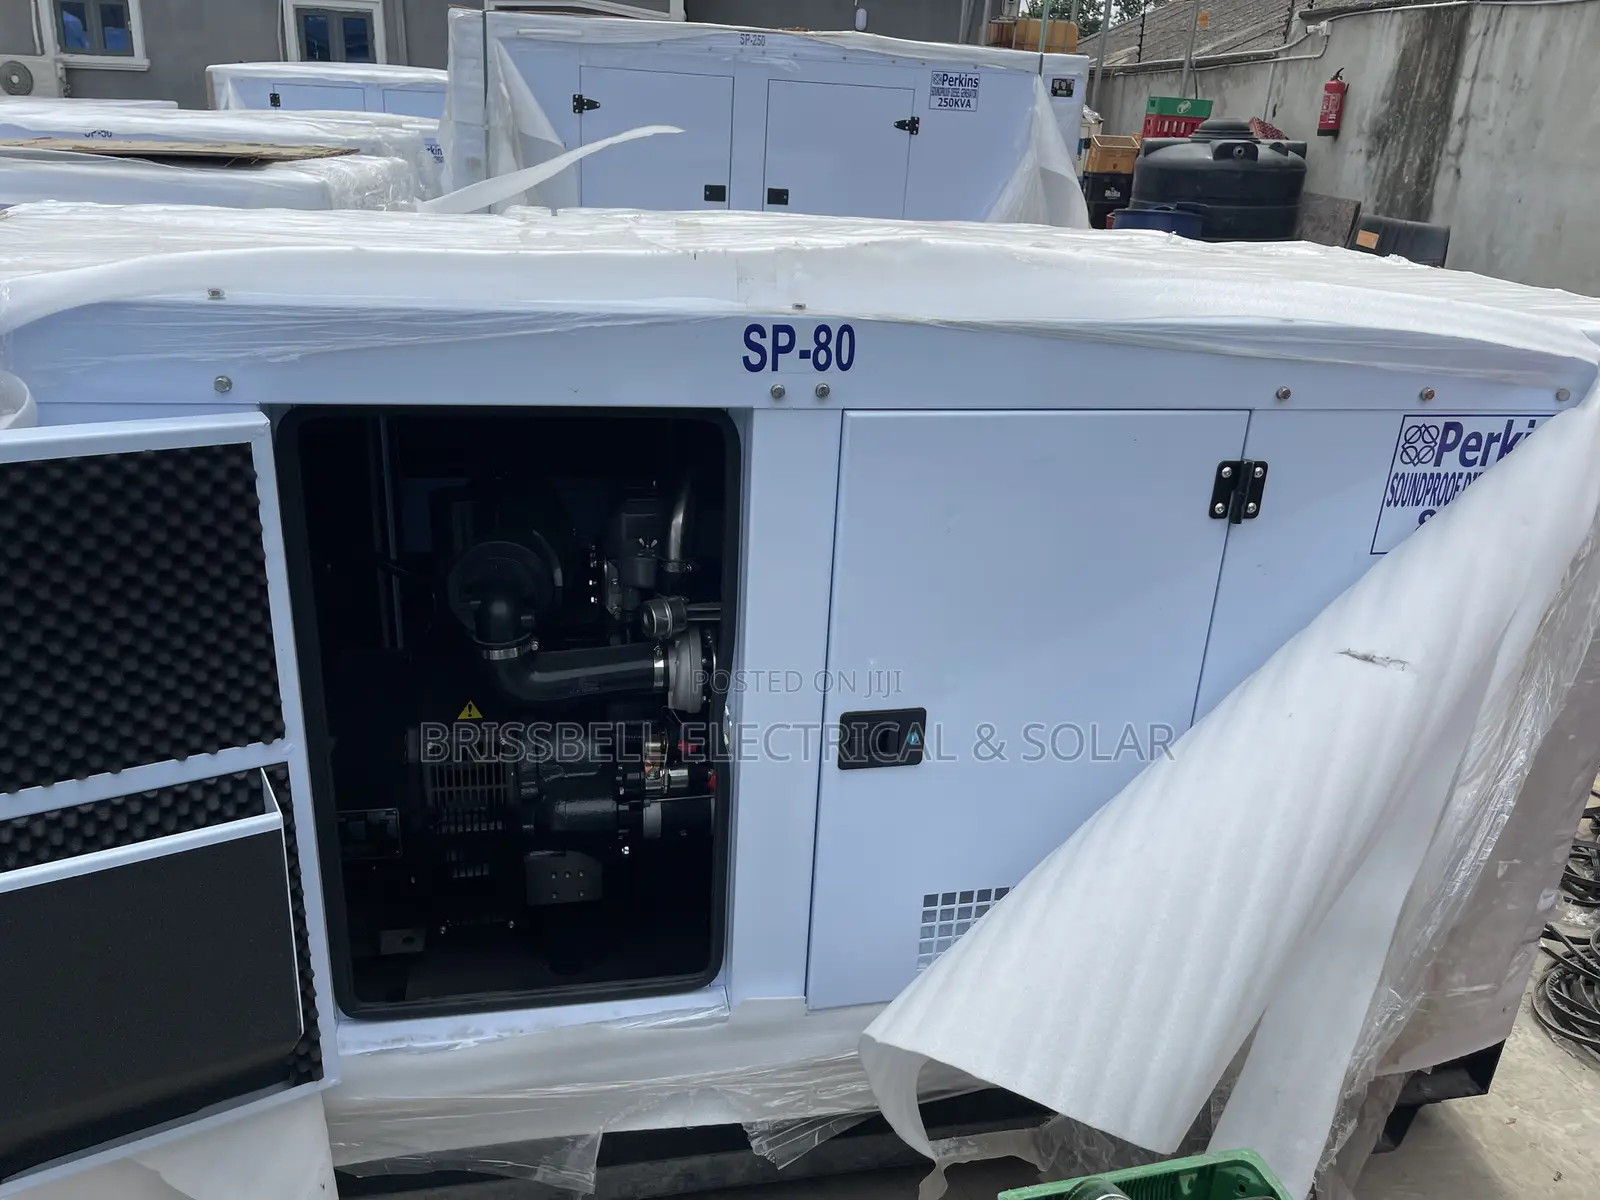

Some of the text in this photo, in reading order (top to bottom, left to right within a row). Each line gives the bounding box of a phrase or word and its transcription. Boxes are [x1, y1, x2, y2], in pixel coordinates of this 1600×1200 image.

[740, 33, 765, 47] SP-250
[942, 73, 979, 88] Perkins
[938, 97, 972, 109] 250KVA
[742, 323, 856, 373] SP-80
[1386, 472, 1464, 508] SOUNDPROOF
